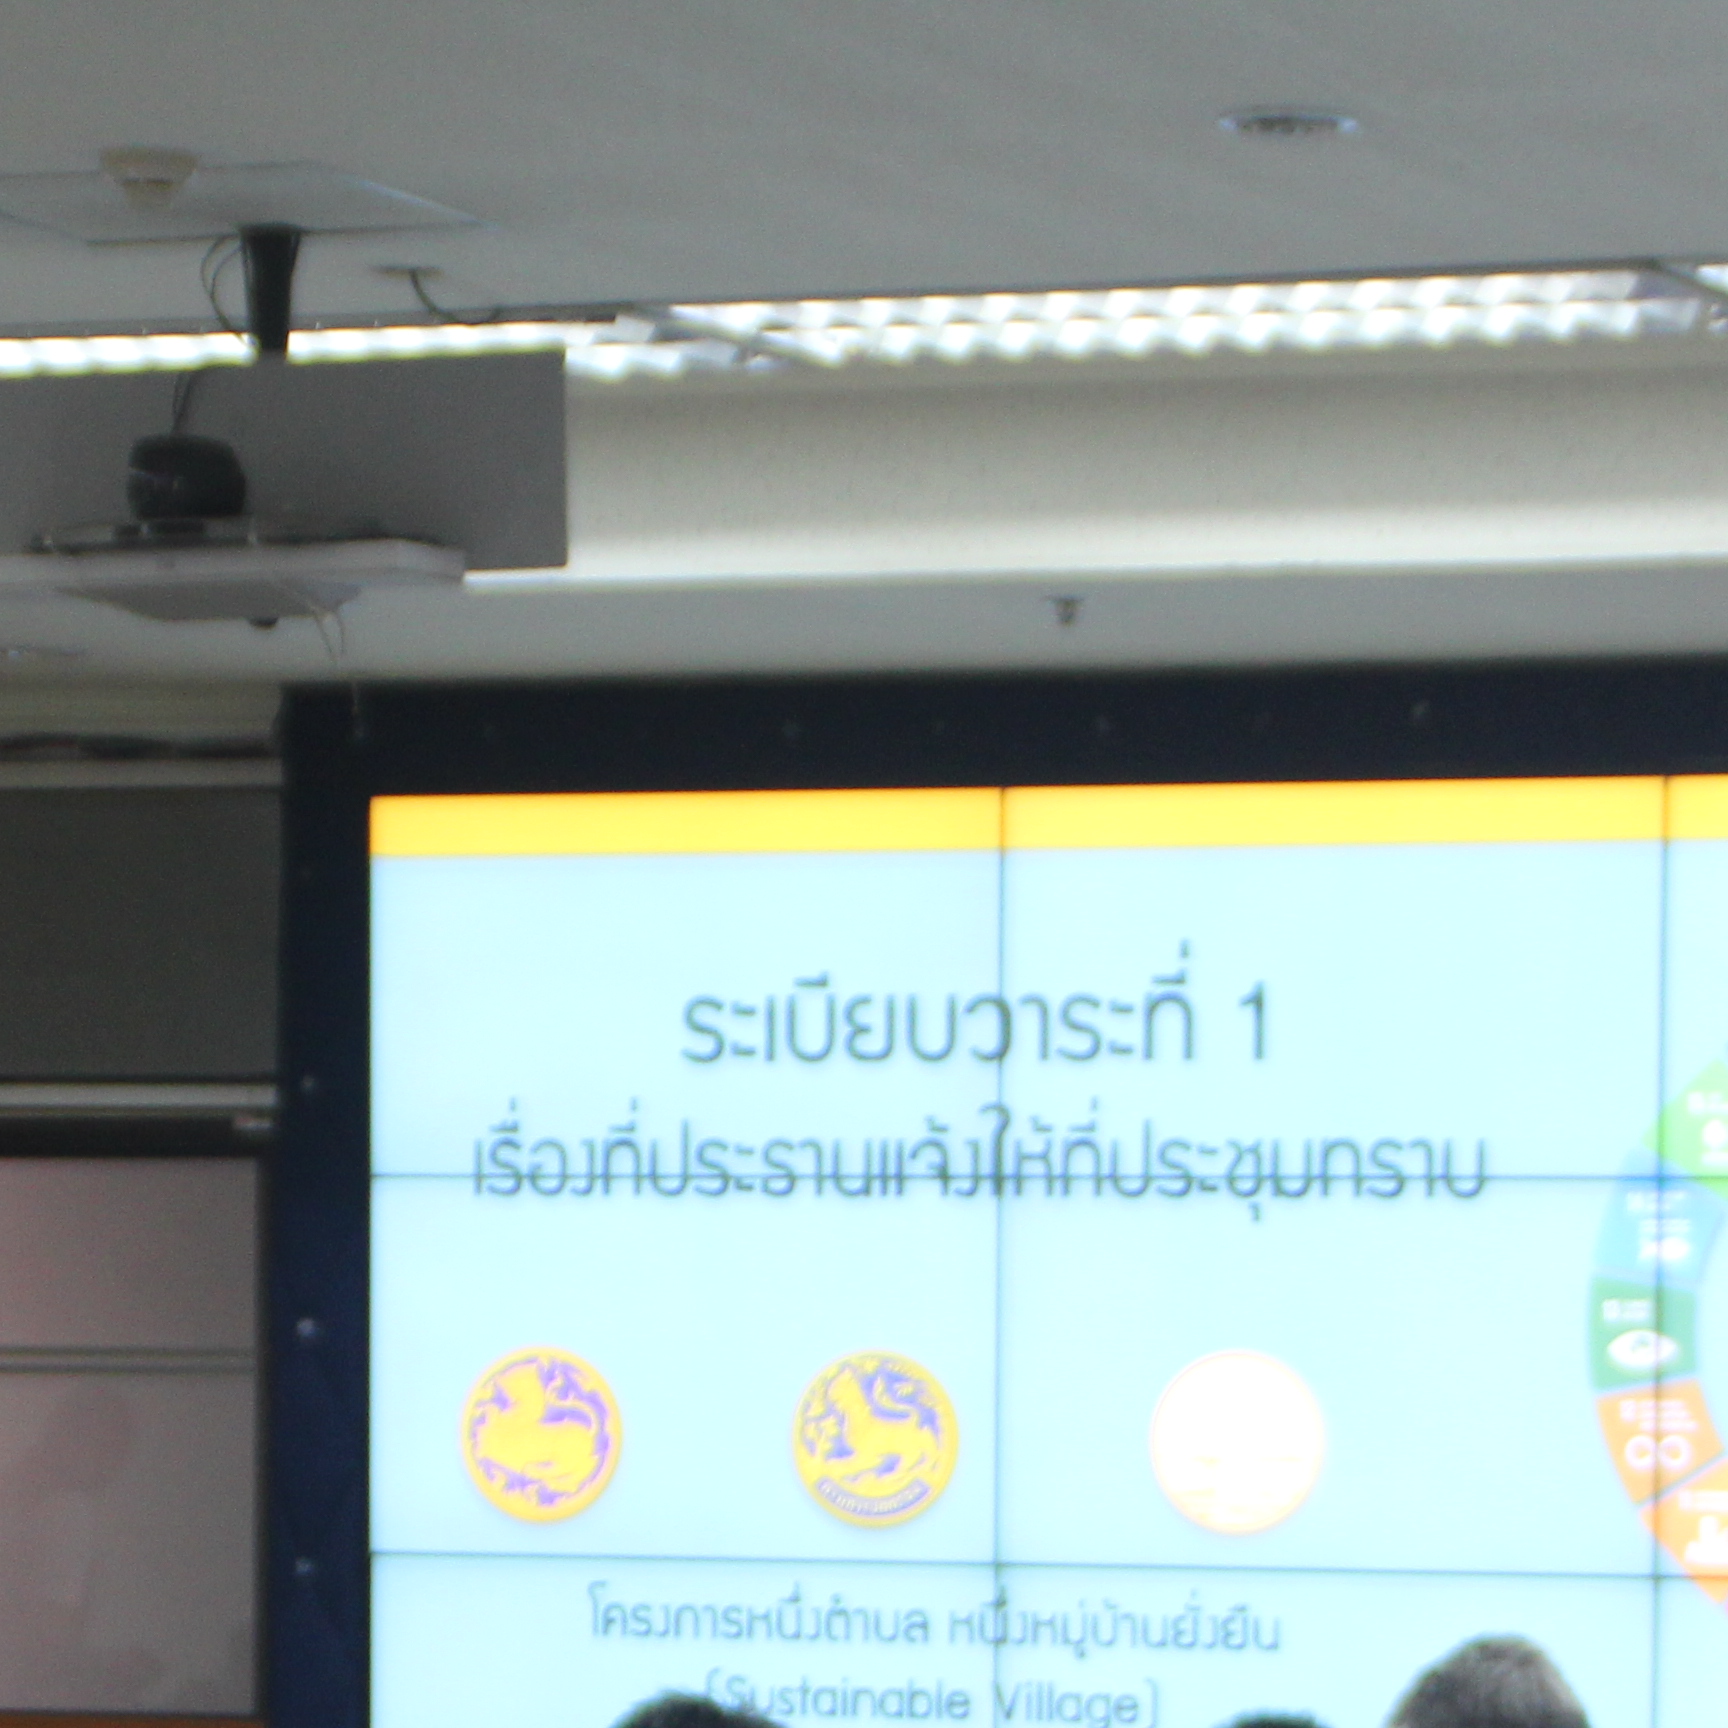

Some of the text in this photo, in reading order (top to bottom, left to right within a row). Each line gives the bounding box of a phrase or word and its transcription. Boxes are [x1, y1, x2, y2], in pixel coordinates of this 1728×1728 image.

[683, 941, 1269, 1063] ระเบียบวาระที่ 1
[473, 1098, 1487, 1222] เรื่องที่ประธานแจ้งให้ที่ประชุมทราบ
[587, 1580, 931, 1643] โครงการหนึ่งตำบล
